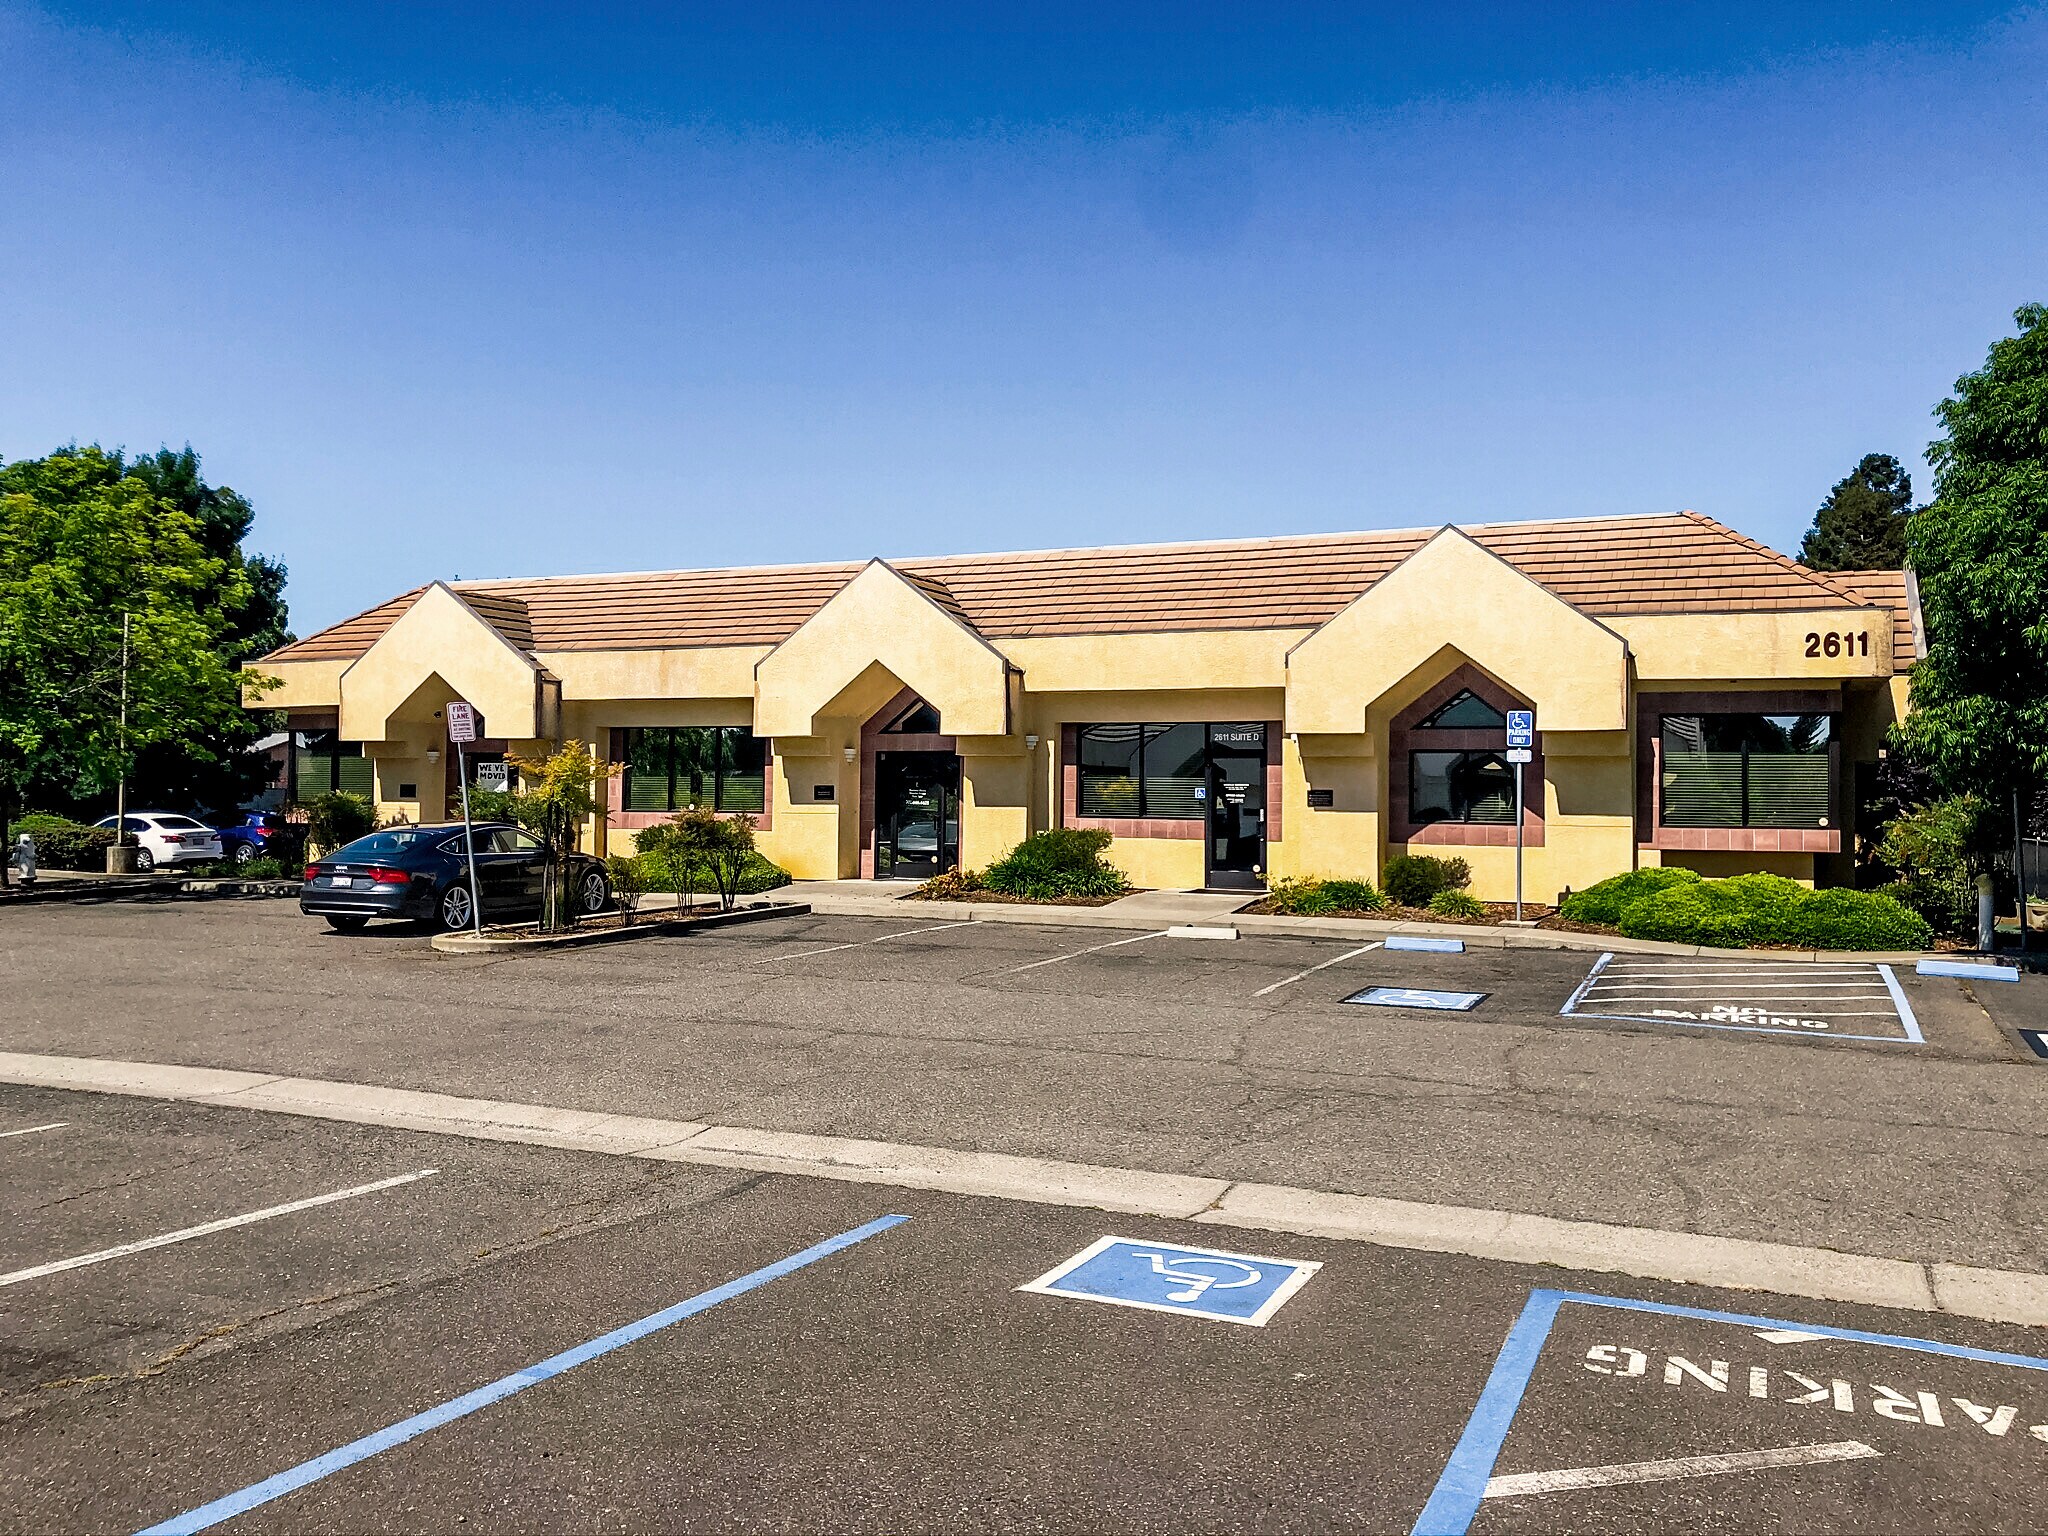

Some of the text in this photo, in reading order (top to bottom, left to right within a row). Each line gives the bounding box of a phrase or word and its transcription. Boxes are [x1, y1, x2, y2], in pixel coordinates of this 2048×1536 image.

[1805, 631, 1868, 658] 2611
[452, 705, 467, 713] FIRE
[1214, 733, 1260, 741] 2611 SUITE D
[480, 772, 506, 780] MOVED
[1652, 1009, 1829, 1029] PARKING
